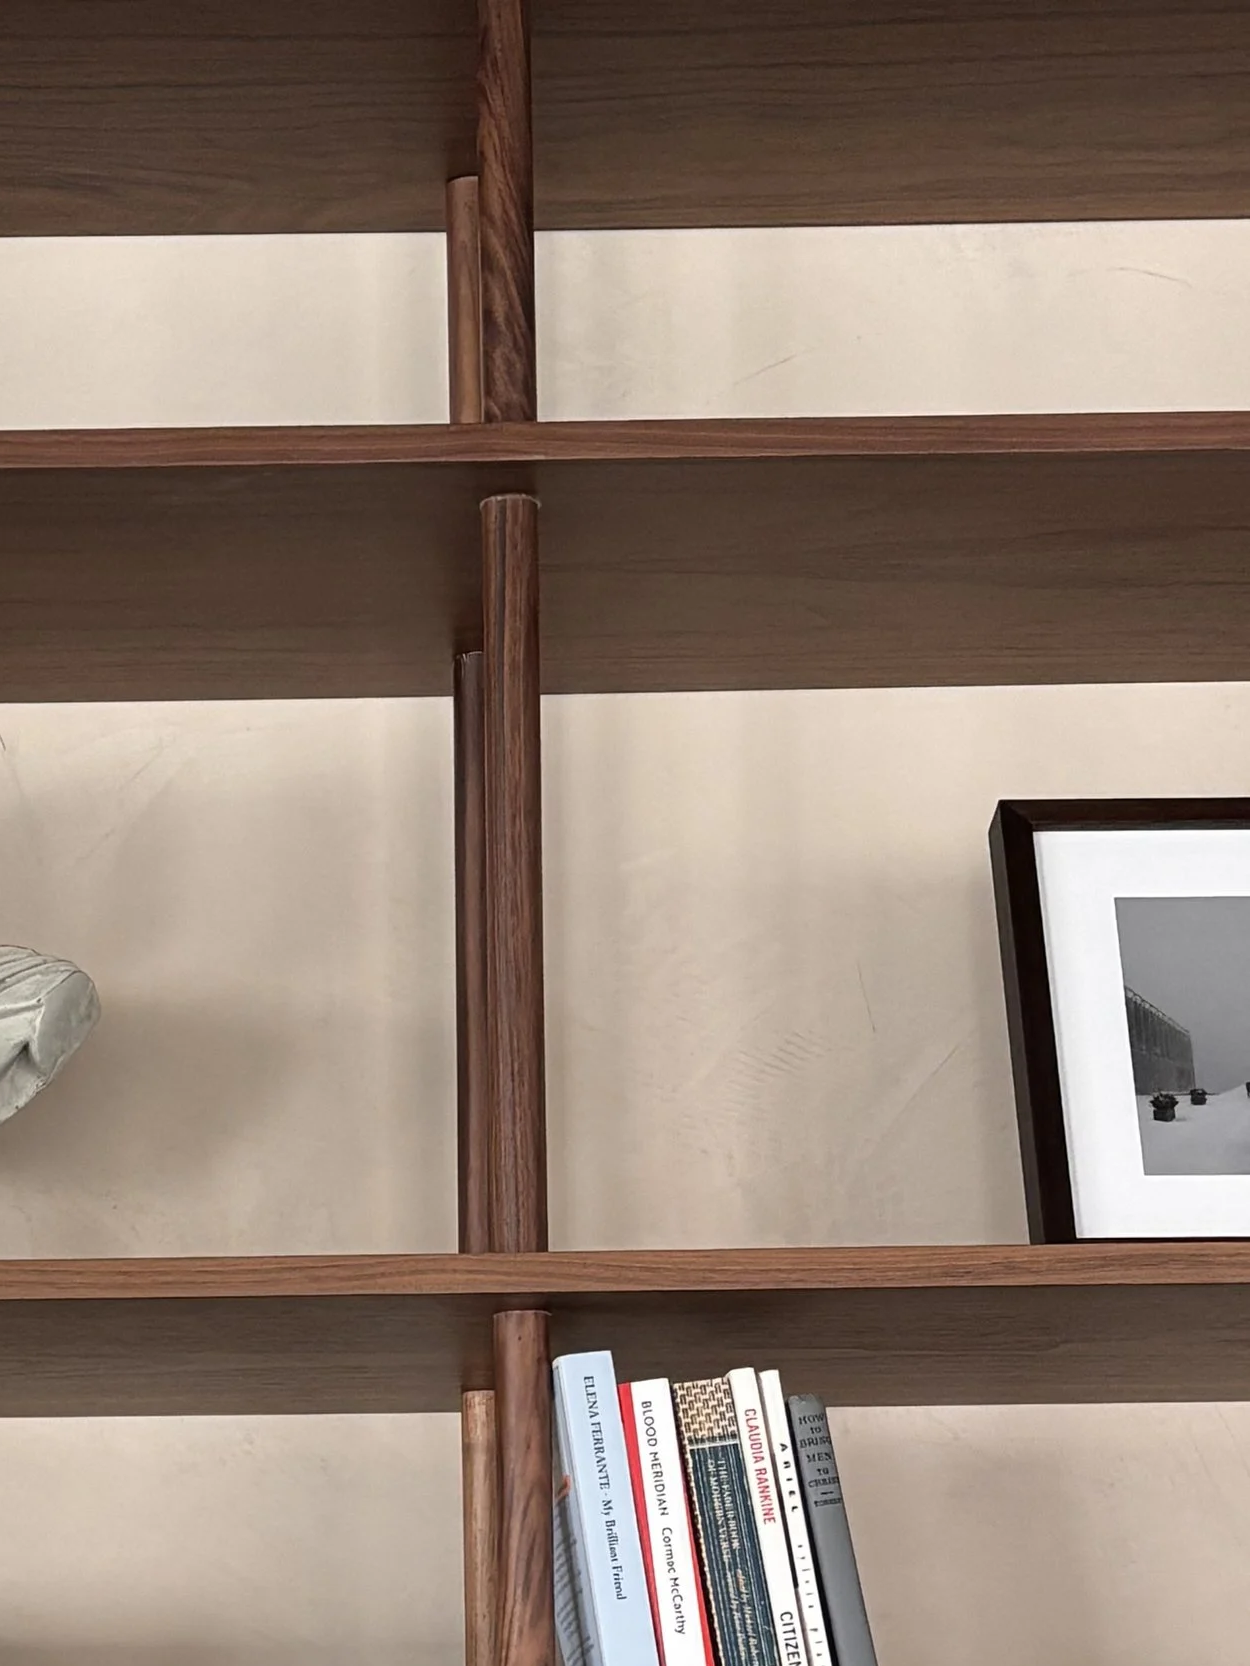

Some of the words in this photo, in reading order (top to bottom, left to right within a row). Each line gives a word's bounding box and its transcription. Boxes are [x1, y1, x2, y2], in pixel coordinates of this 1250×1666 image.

[583, 1376, 600, 1419] ELENA
[641, 1401, 658, 1447] BLOOD
[591, 1422, 611, 1490] FERRANTE
[744, 1408, 766, 1464] CLAUDIA
[755, 1467, 776, 1525] RANKINE
[602, 1499, 612, 1517] My
[649, 1452, 670, 1517] MERIDIAN
[662, 1527, 677, 1574] Cormac
[612, 1565, 627, 1601] Friend
[669, 1577, 688, 1635] McCarthy
